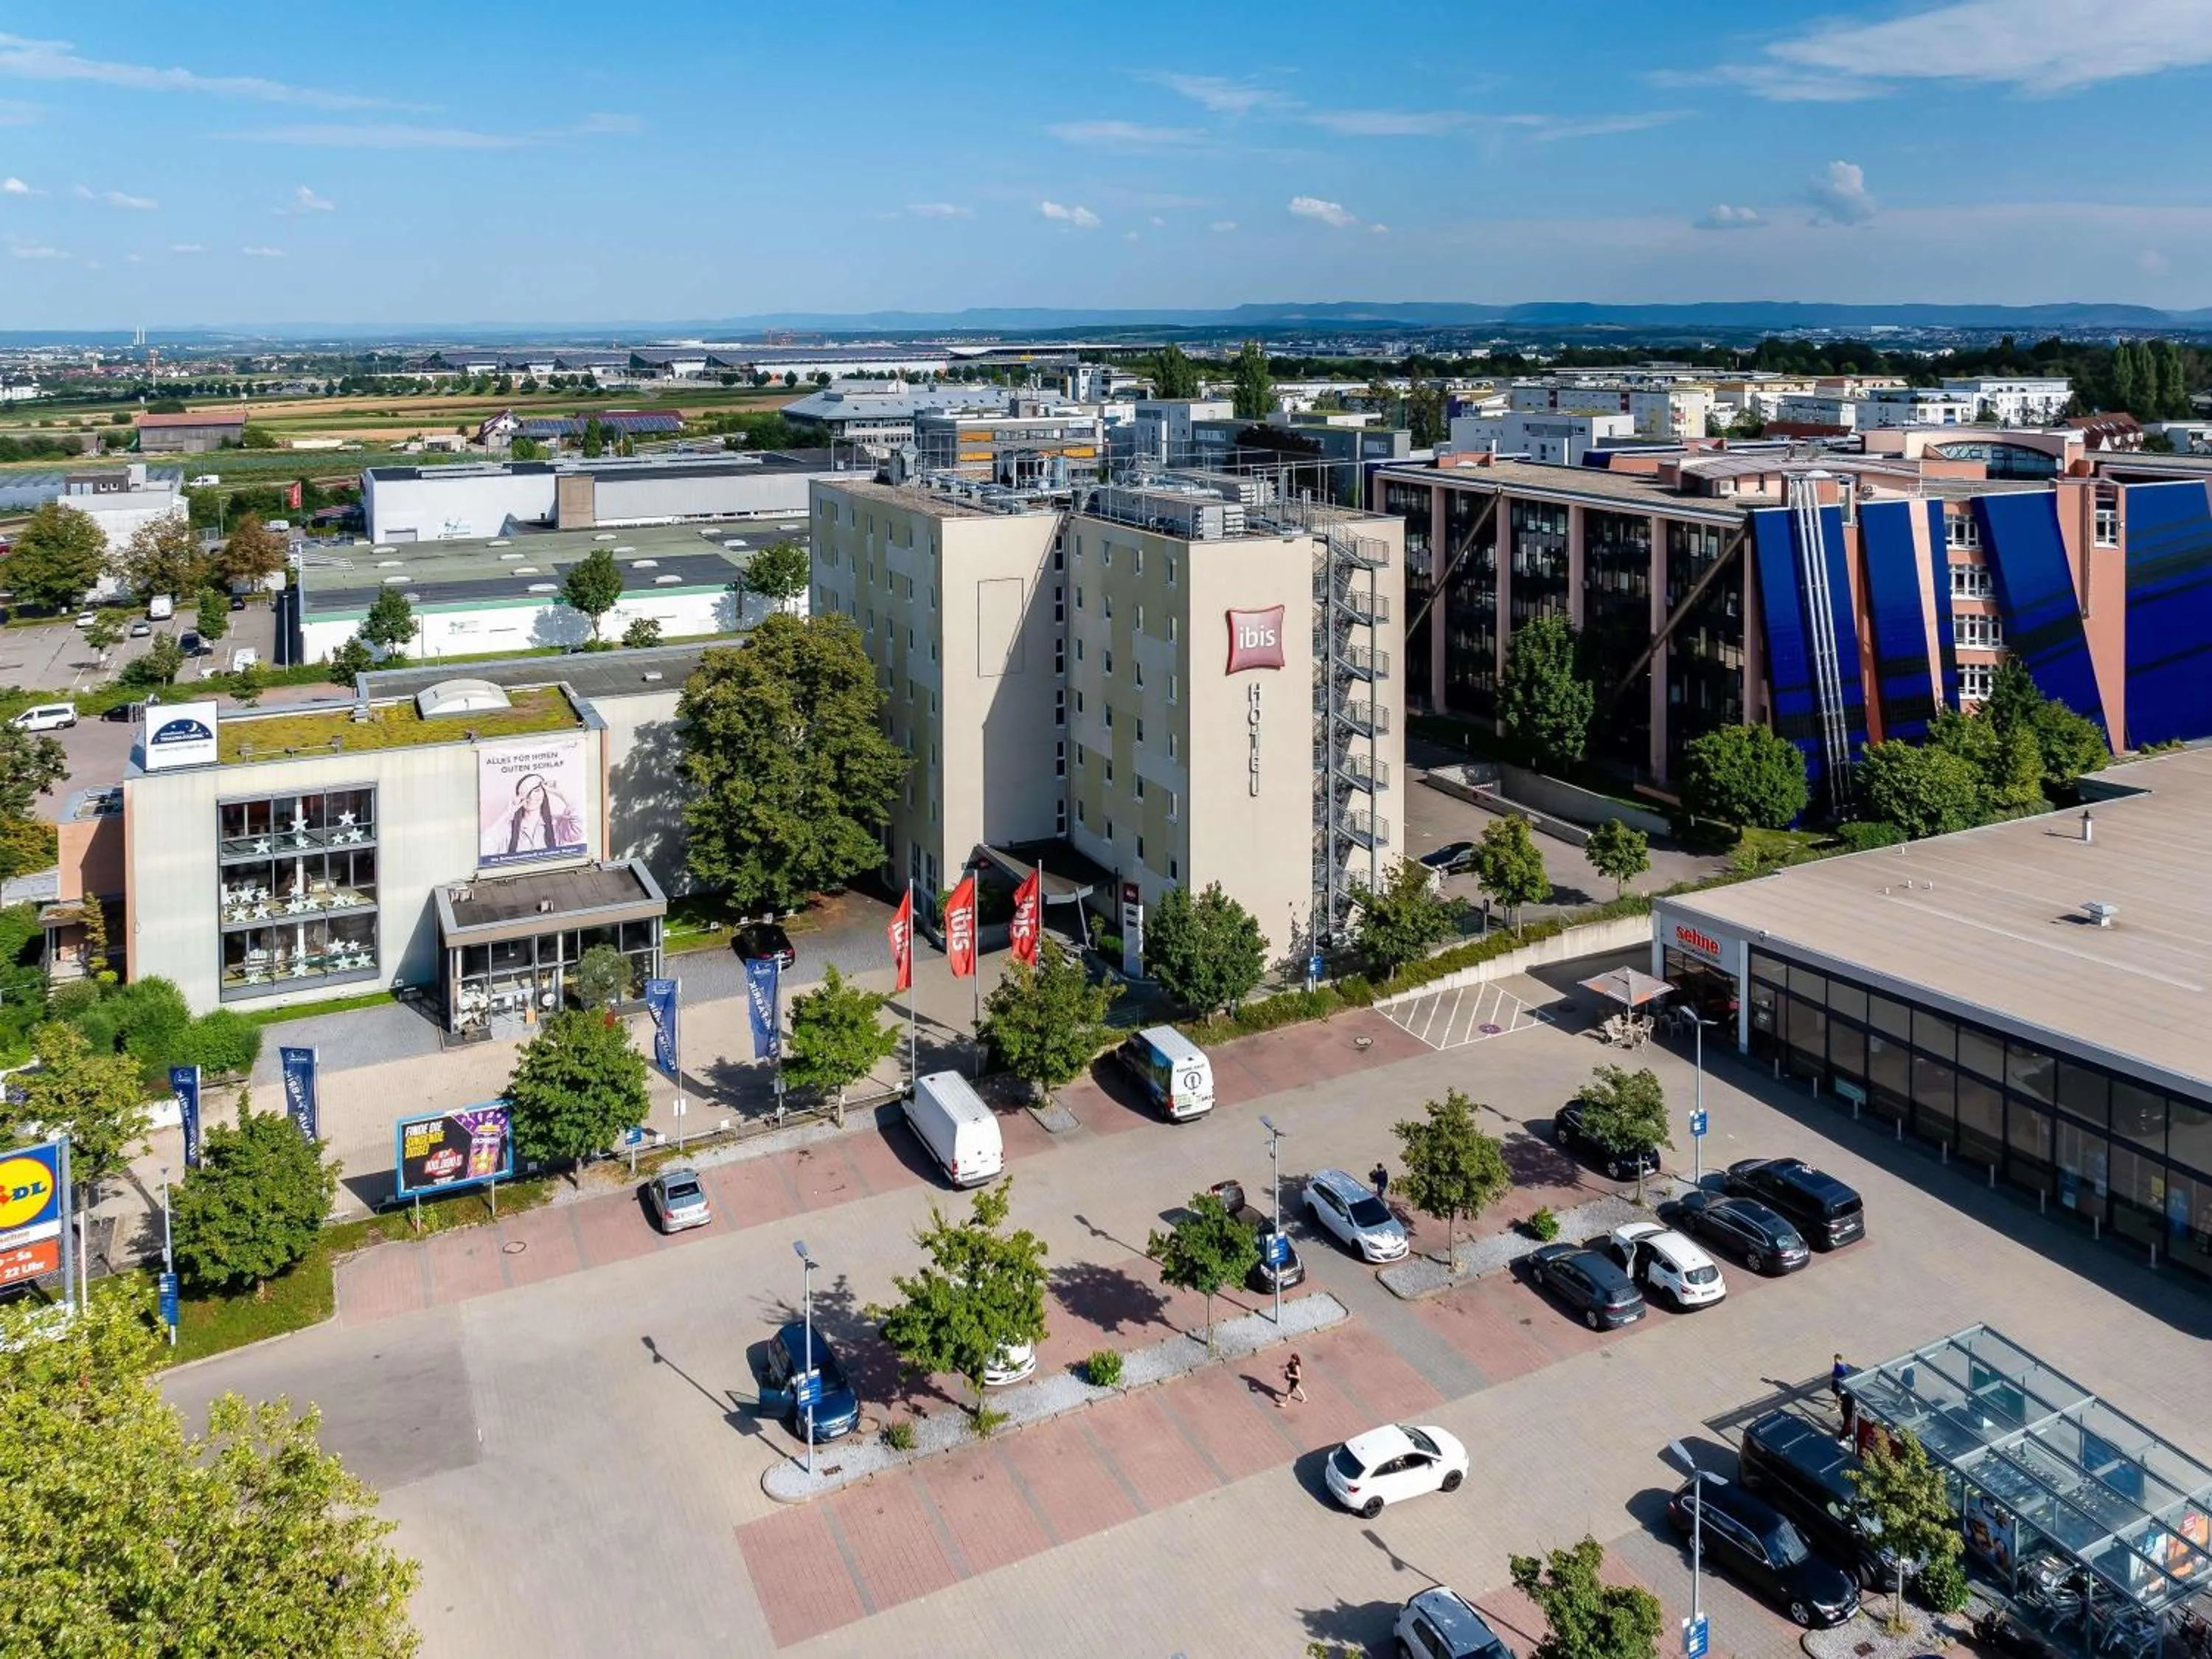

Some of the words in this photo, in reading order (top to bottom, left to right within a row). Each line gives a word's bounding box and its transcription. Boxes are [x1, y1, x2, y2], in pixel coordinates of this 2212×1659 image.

[1239, 626, 1276, 649] ibis
[1248, 682, 1261, 797] HOTEL
[486, 756, 511, 765] ALLES
[501, 764, 530, 773] GUTEN
[533, 760, 564, 770] SCHLAF
[950, 906, 973, 952] ibis
[1674, 925, 1721, 956] sehne
[17, 1251, 33, 1262] Sa
[4, 1266, 20, 1279] 22
[22, 1261, 46, 1274] Uhr
